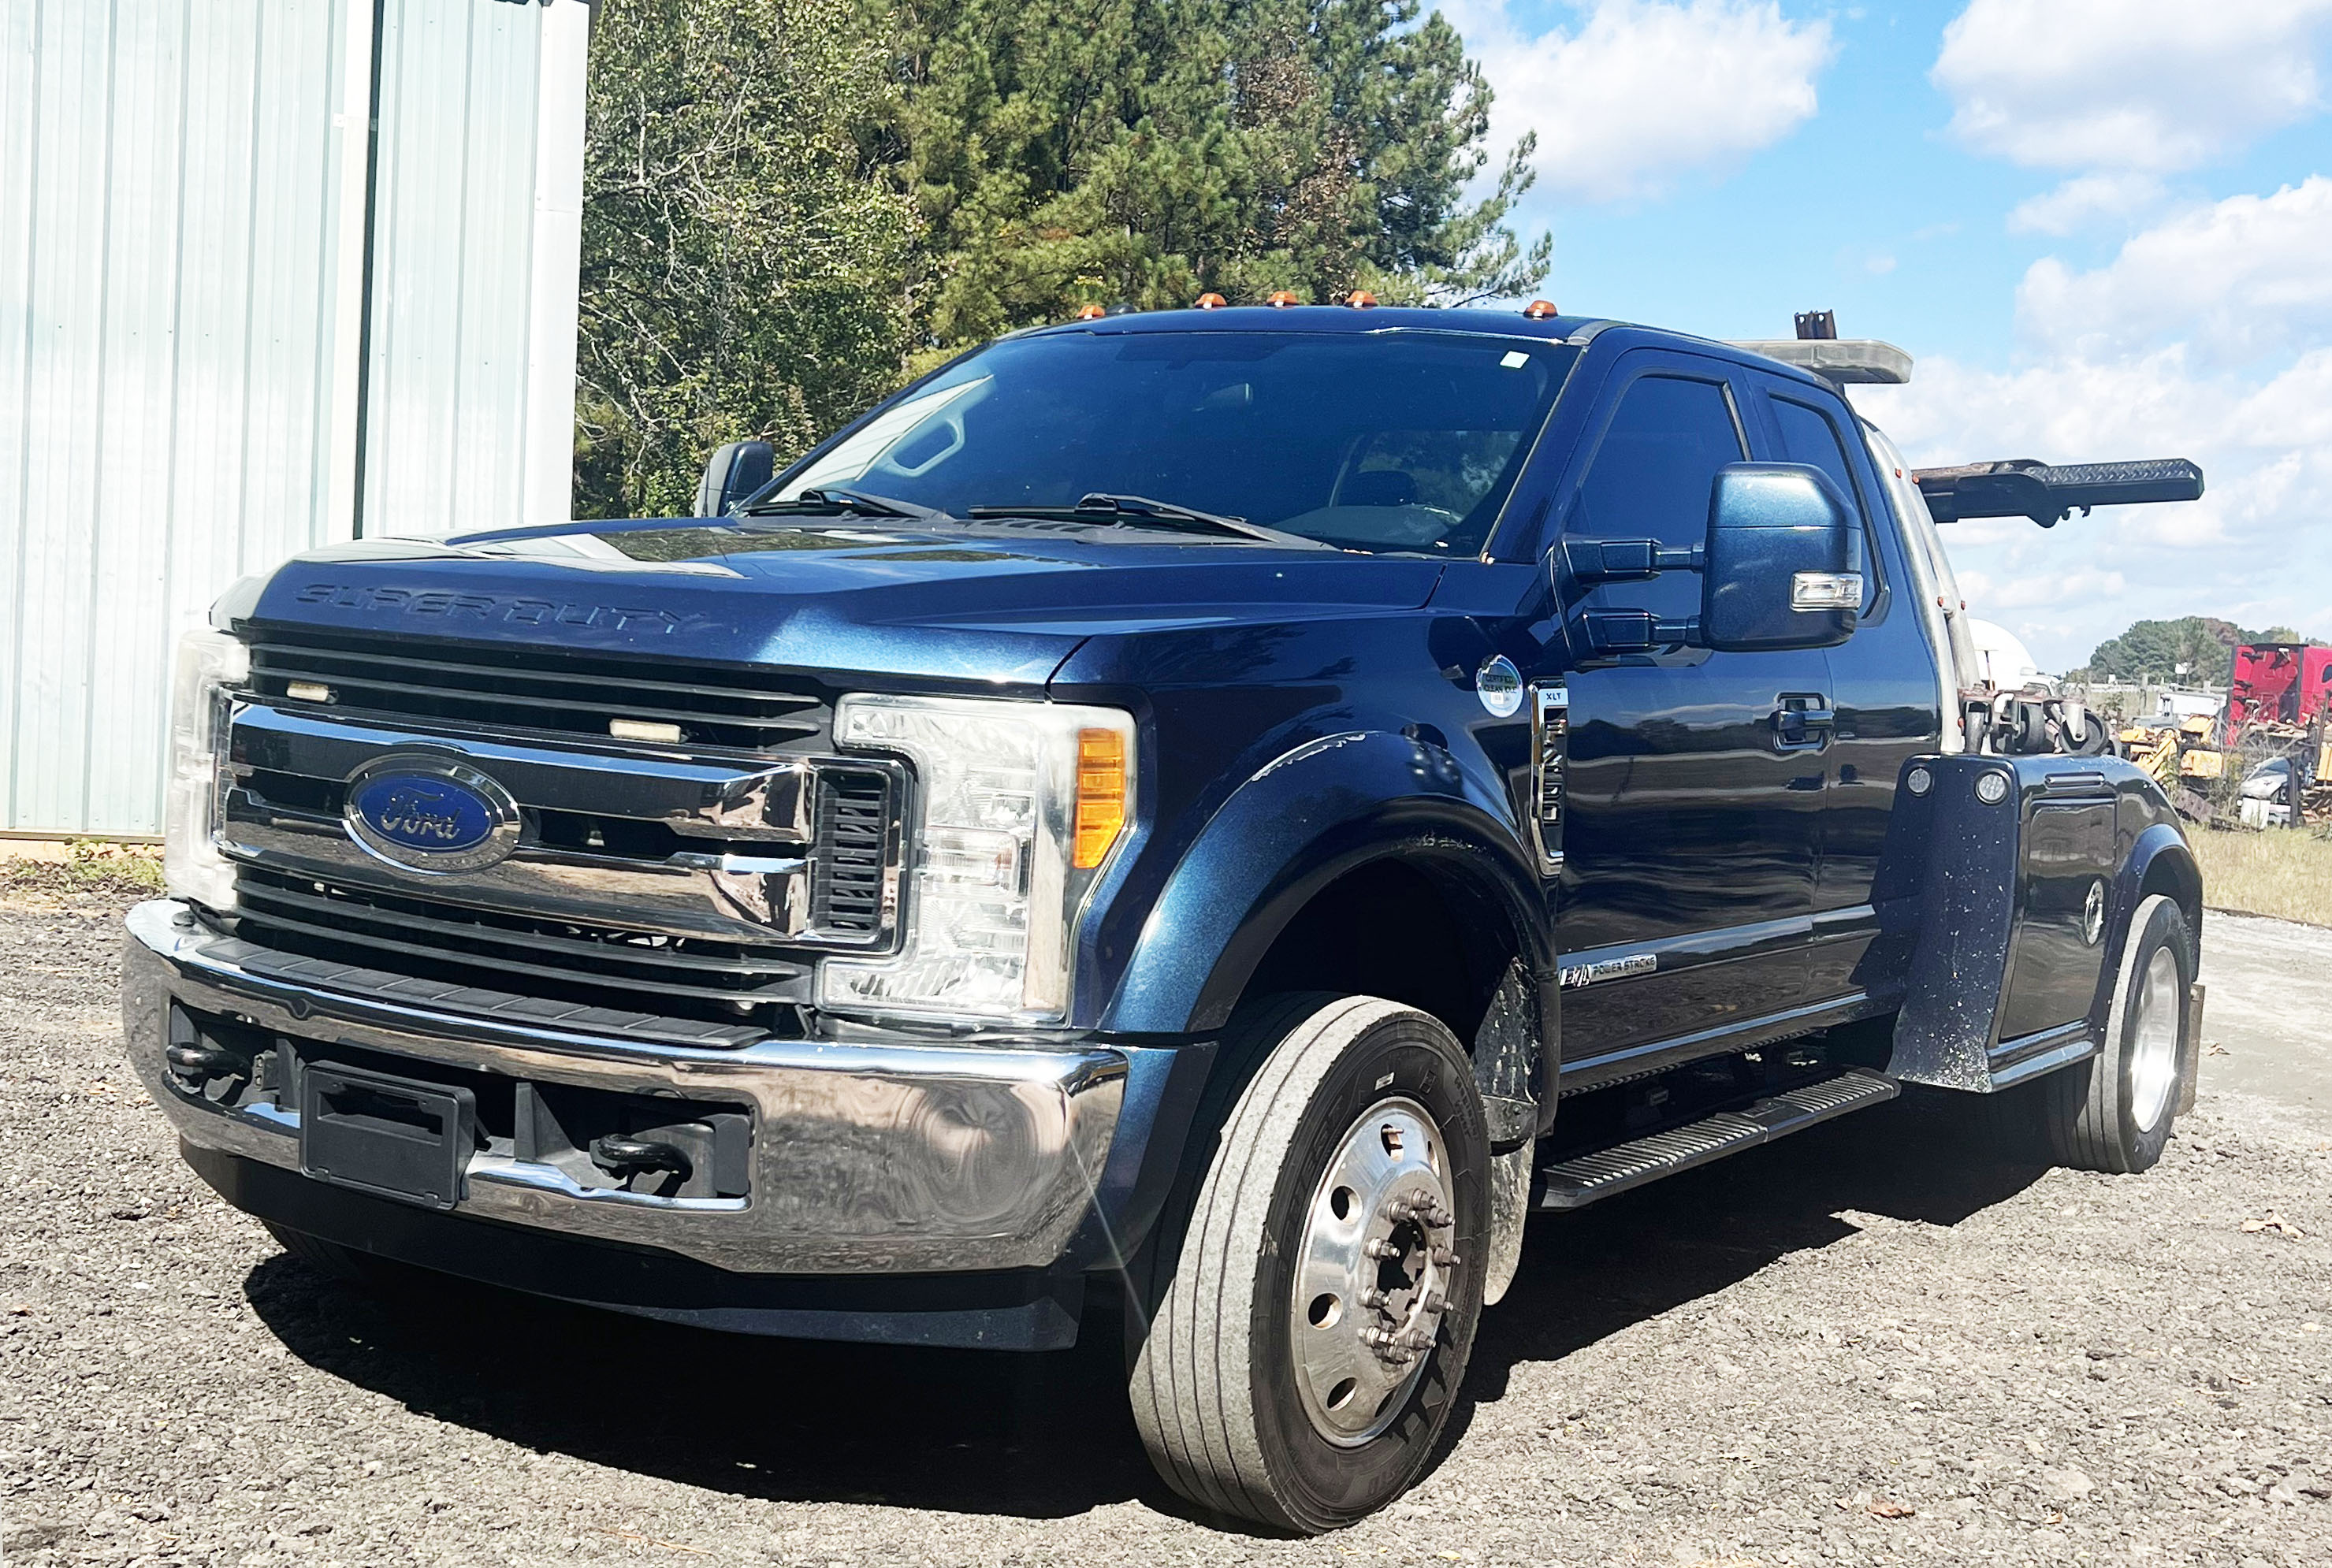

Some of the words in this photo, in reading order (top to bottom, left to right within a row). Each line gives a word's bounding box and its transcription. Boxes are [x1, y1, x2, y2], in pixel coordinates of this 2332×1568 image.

[296, 584, 496, 620] SUPER
[503, 599, 707, 635] DUTY
[1545, 692, 1562, 701] XLT
[380, 786, 463, 840] Ford
